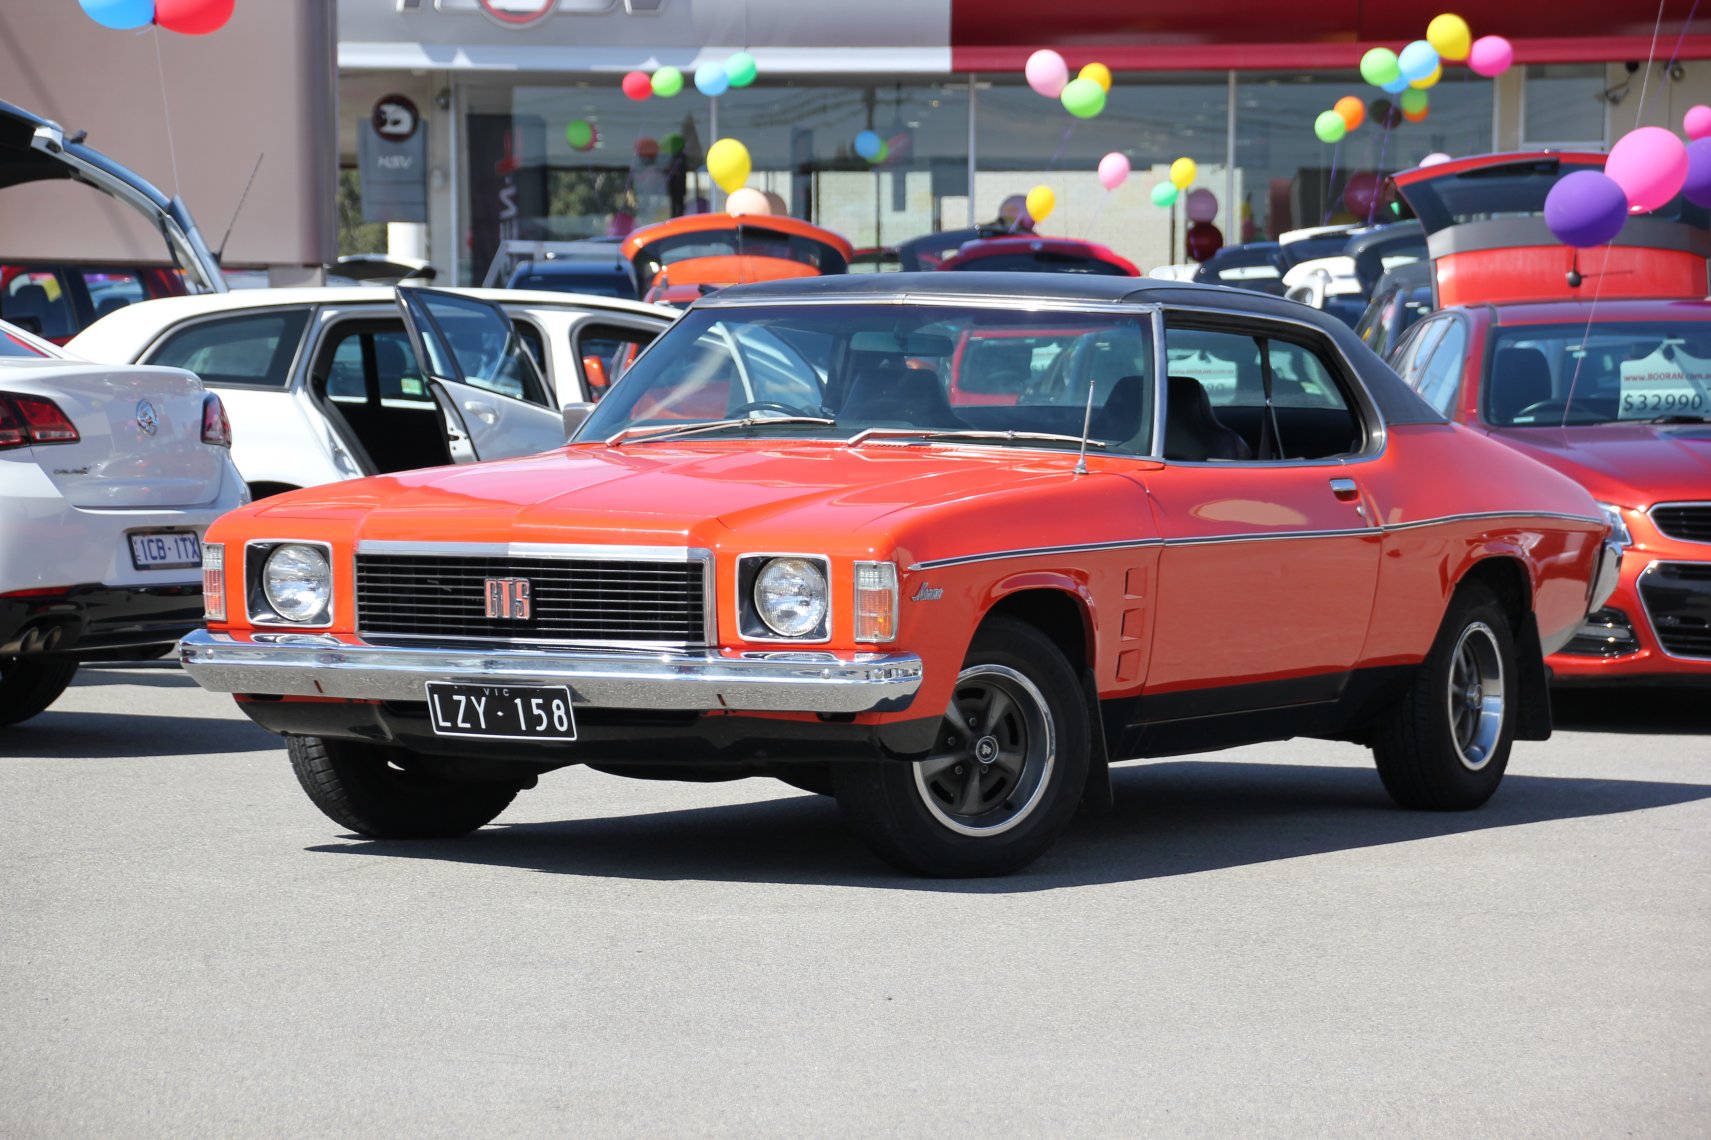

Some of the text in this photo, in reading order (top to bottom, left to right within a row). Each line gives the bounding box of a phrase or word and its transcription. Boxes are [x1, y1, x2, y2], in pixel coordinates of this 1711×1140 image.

[1623, 393, 1703, 412] $32990
[484, 578, 530, 619] GTS
[483, 687, 511, 697] VIC
